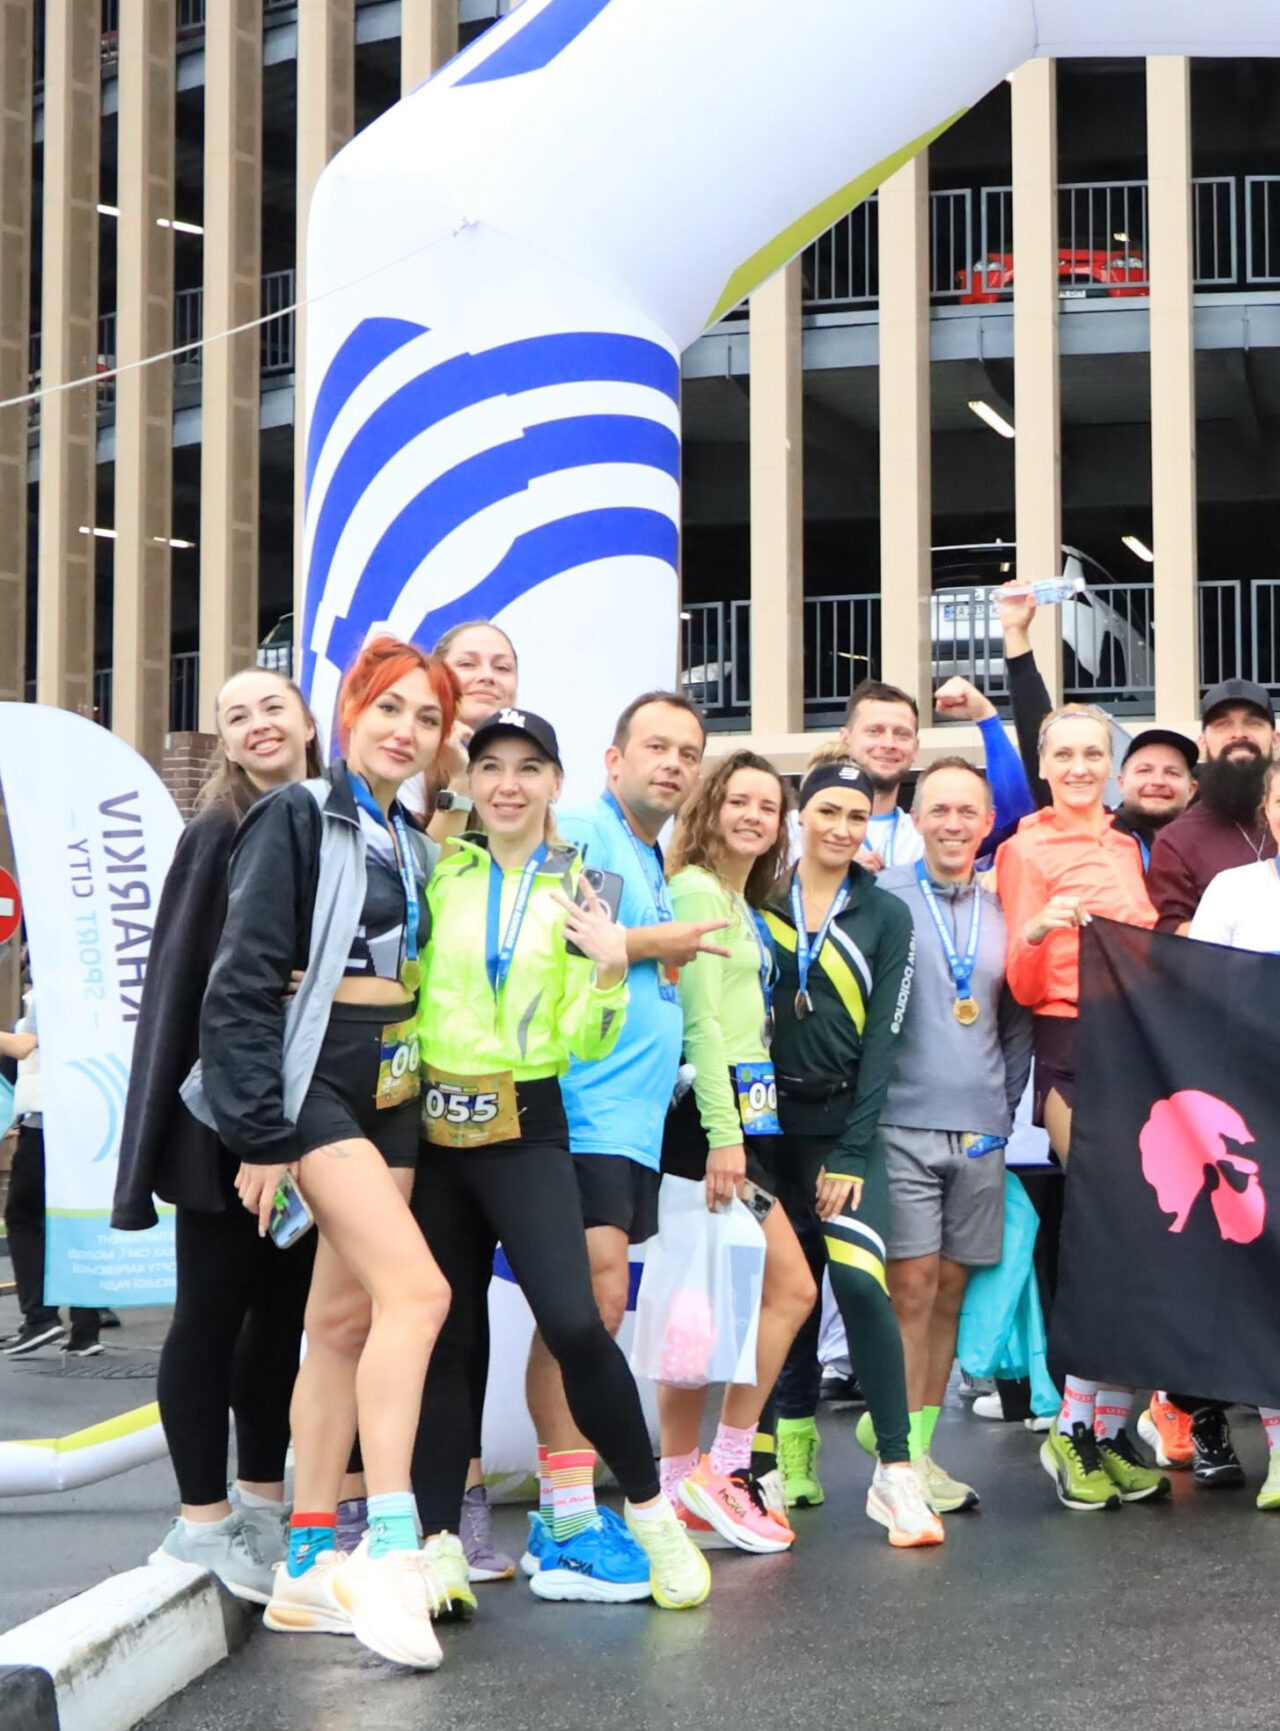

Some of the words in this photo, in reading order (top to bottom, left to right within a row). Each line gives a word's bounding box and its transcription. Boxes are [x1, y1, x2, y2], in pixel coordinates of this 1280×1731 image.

[890, 965, 915, 1034] balance
[425, 1088, 499, 1123] 055
[718, 1488, 746, 1518] HOKA
[557, 1554, 593, 1577] HOKA
